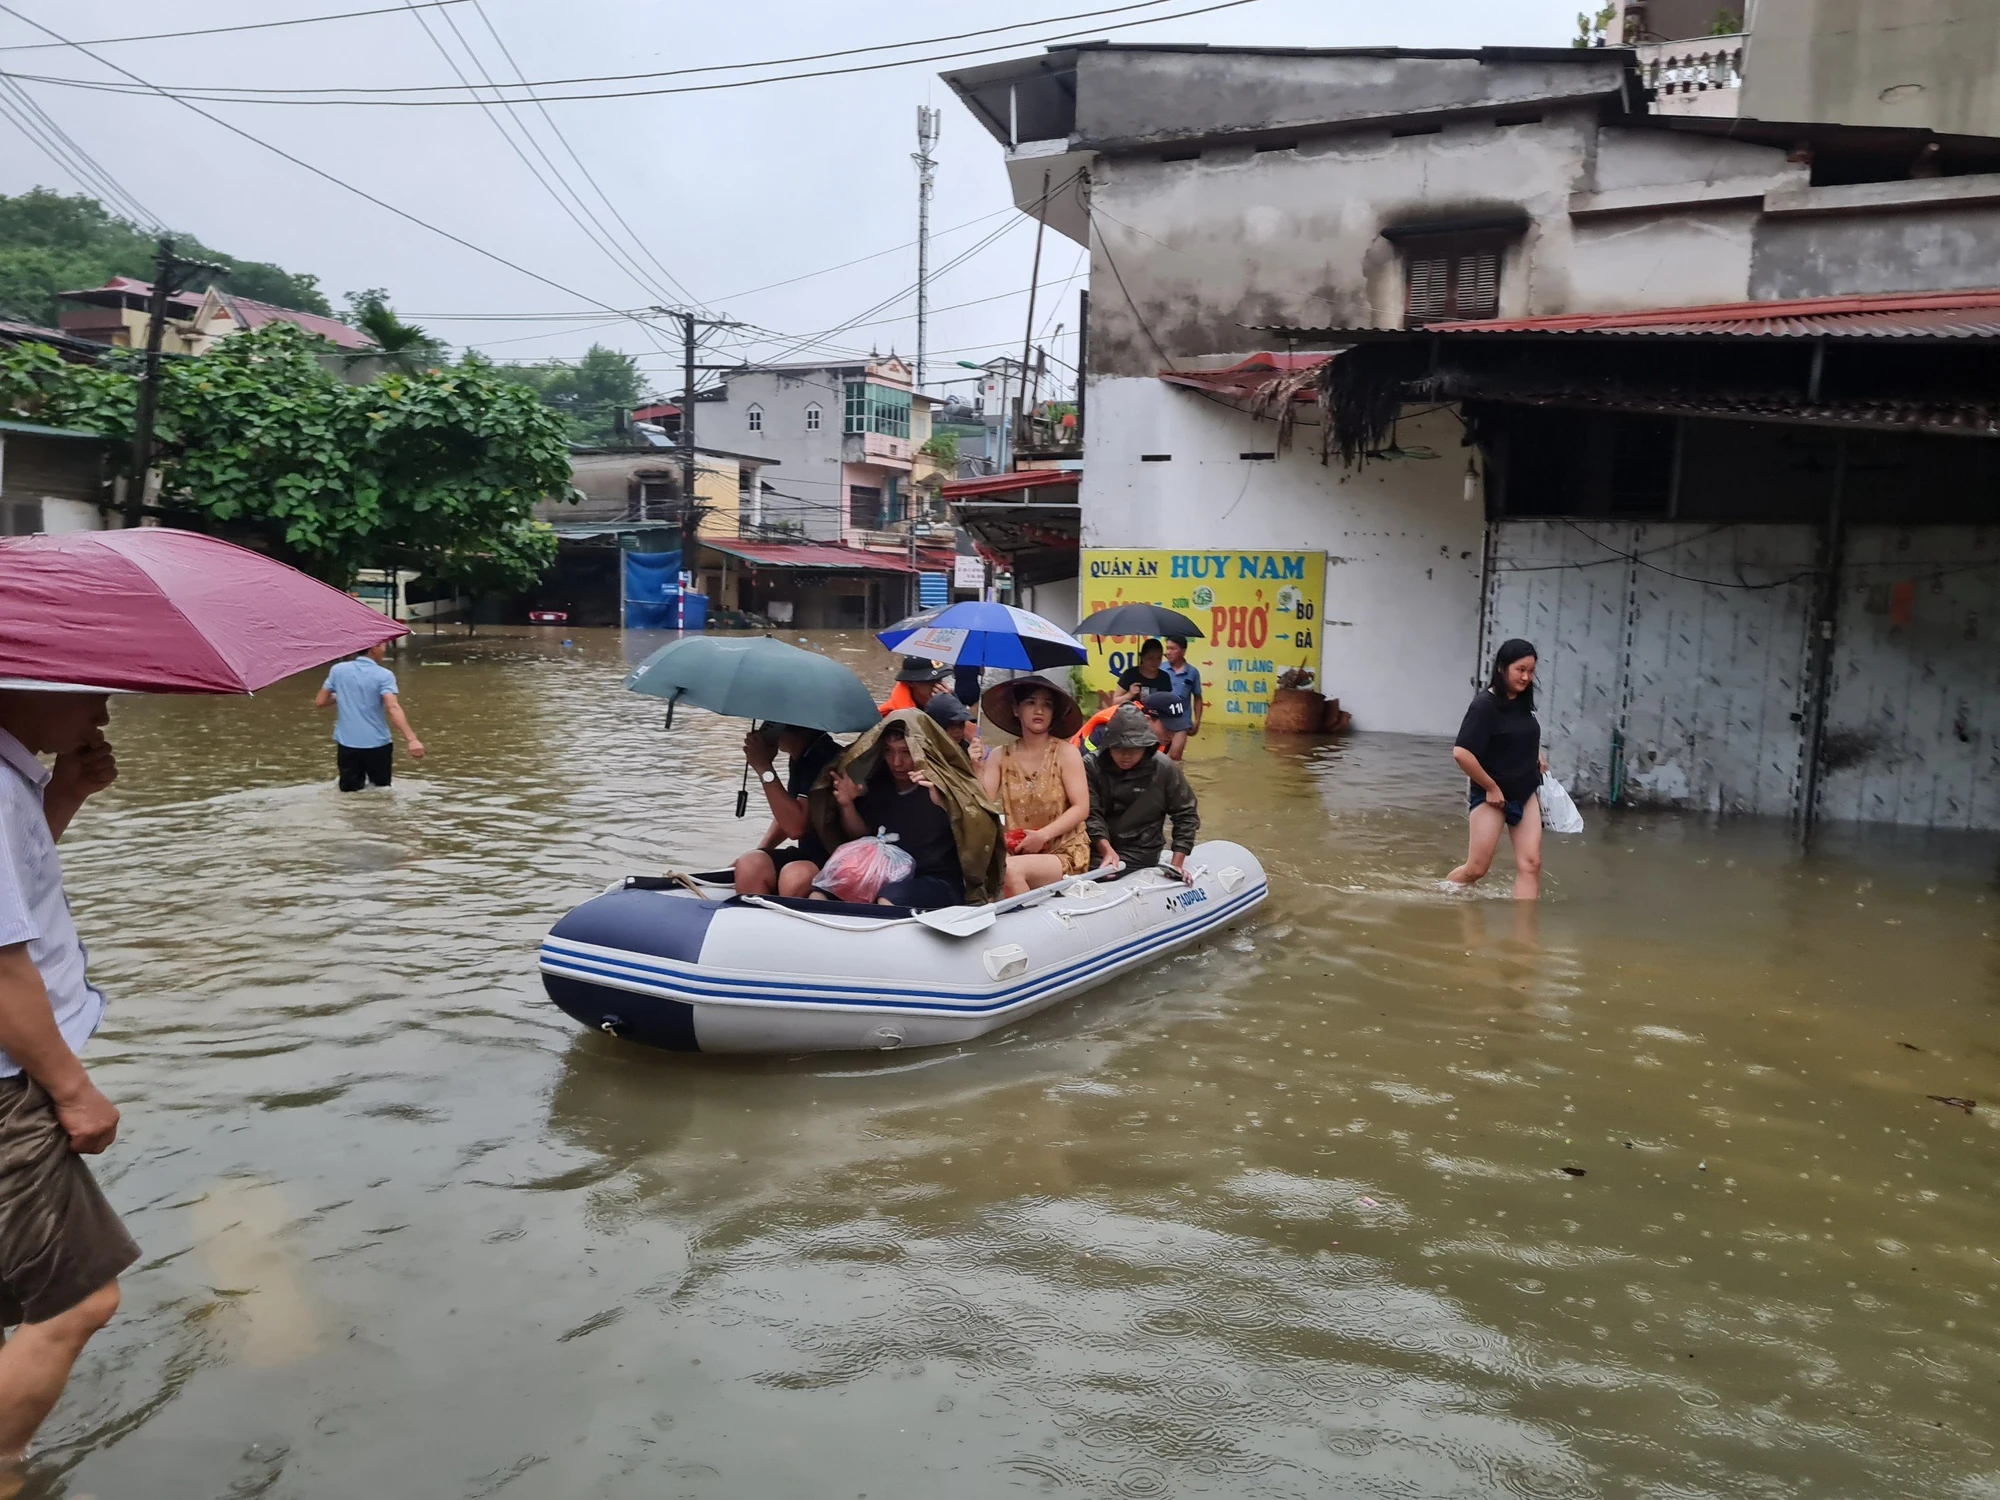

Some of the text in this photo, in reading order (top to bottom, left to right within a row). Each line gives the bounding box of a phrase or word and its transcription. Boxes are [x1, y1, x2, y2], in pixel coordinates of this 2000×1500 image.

[1091, 555, 1305, 580] QUÁN ĂN HUY NAM
[1210, 588, 1270, 649] PHỞ
[1296, 599, 1314, 620] BÒ
[1295, 628, 1313, 648] GÀ
[1227, 657, 1273, 675] VỊT LÀNG
[1253, 678, 1267, 693] GÀ
